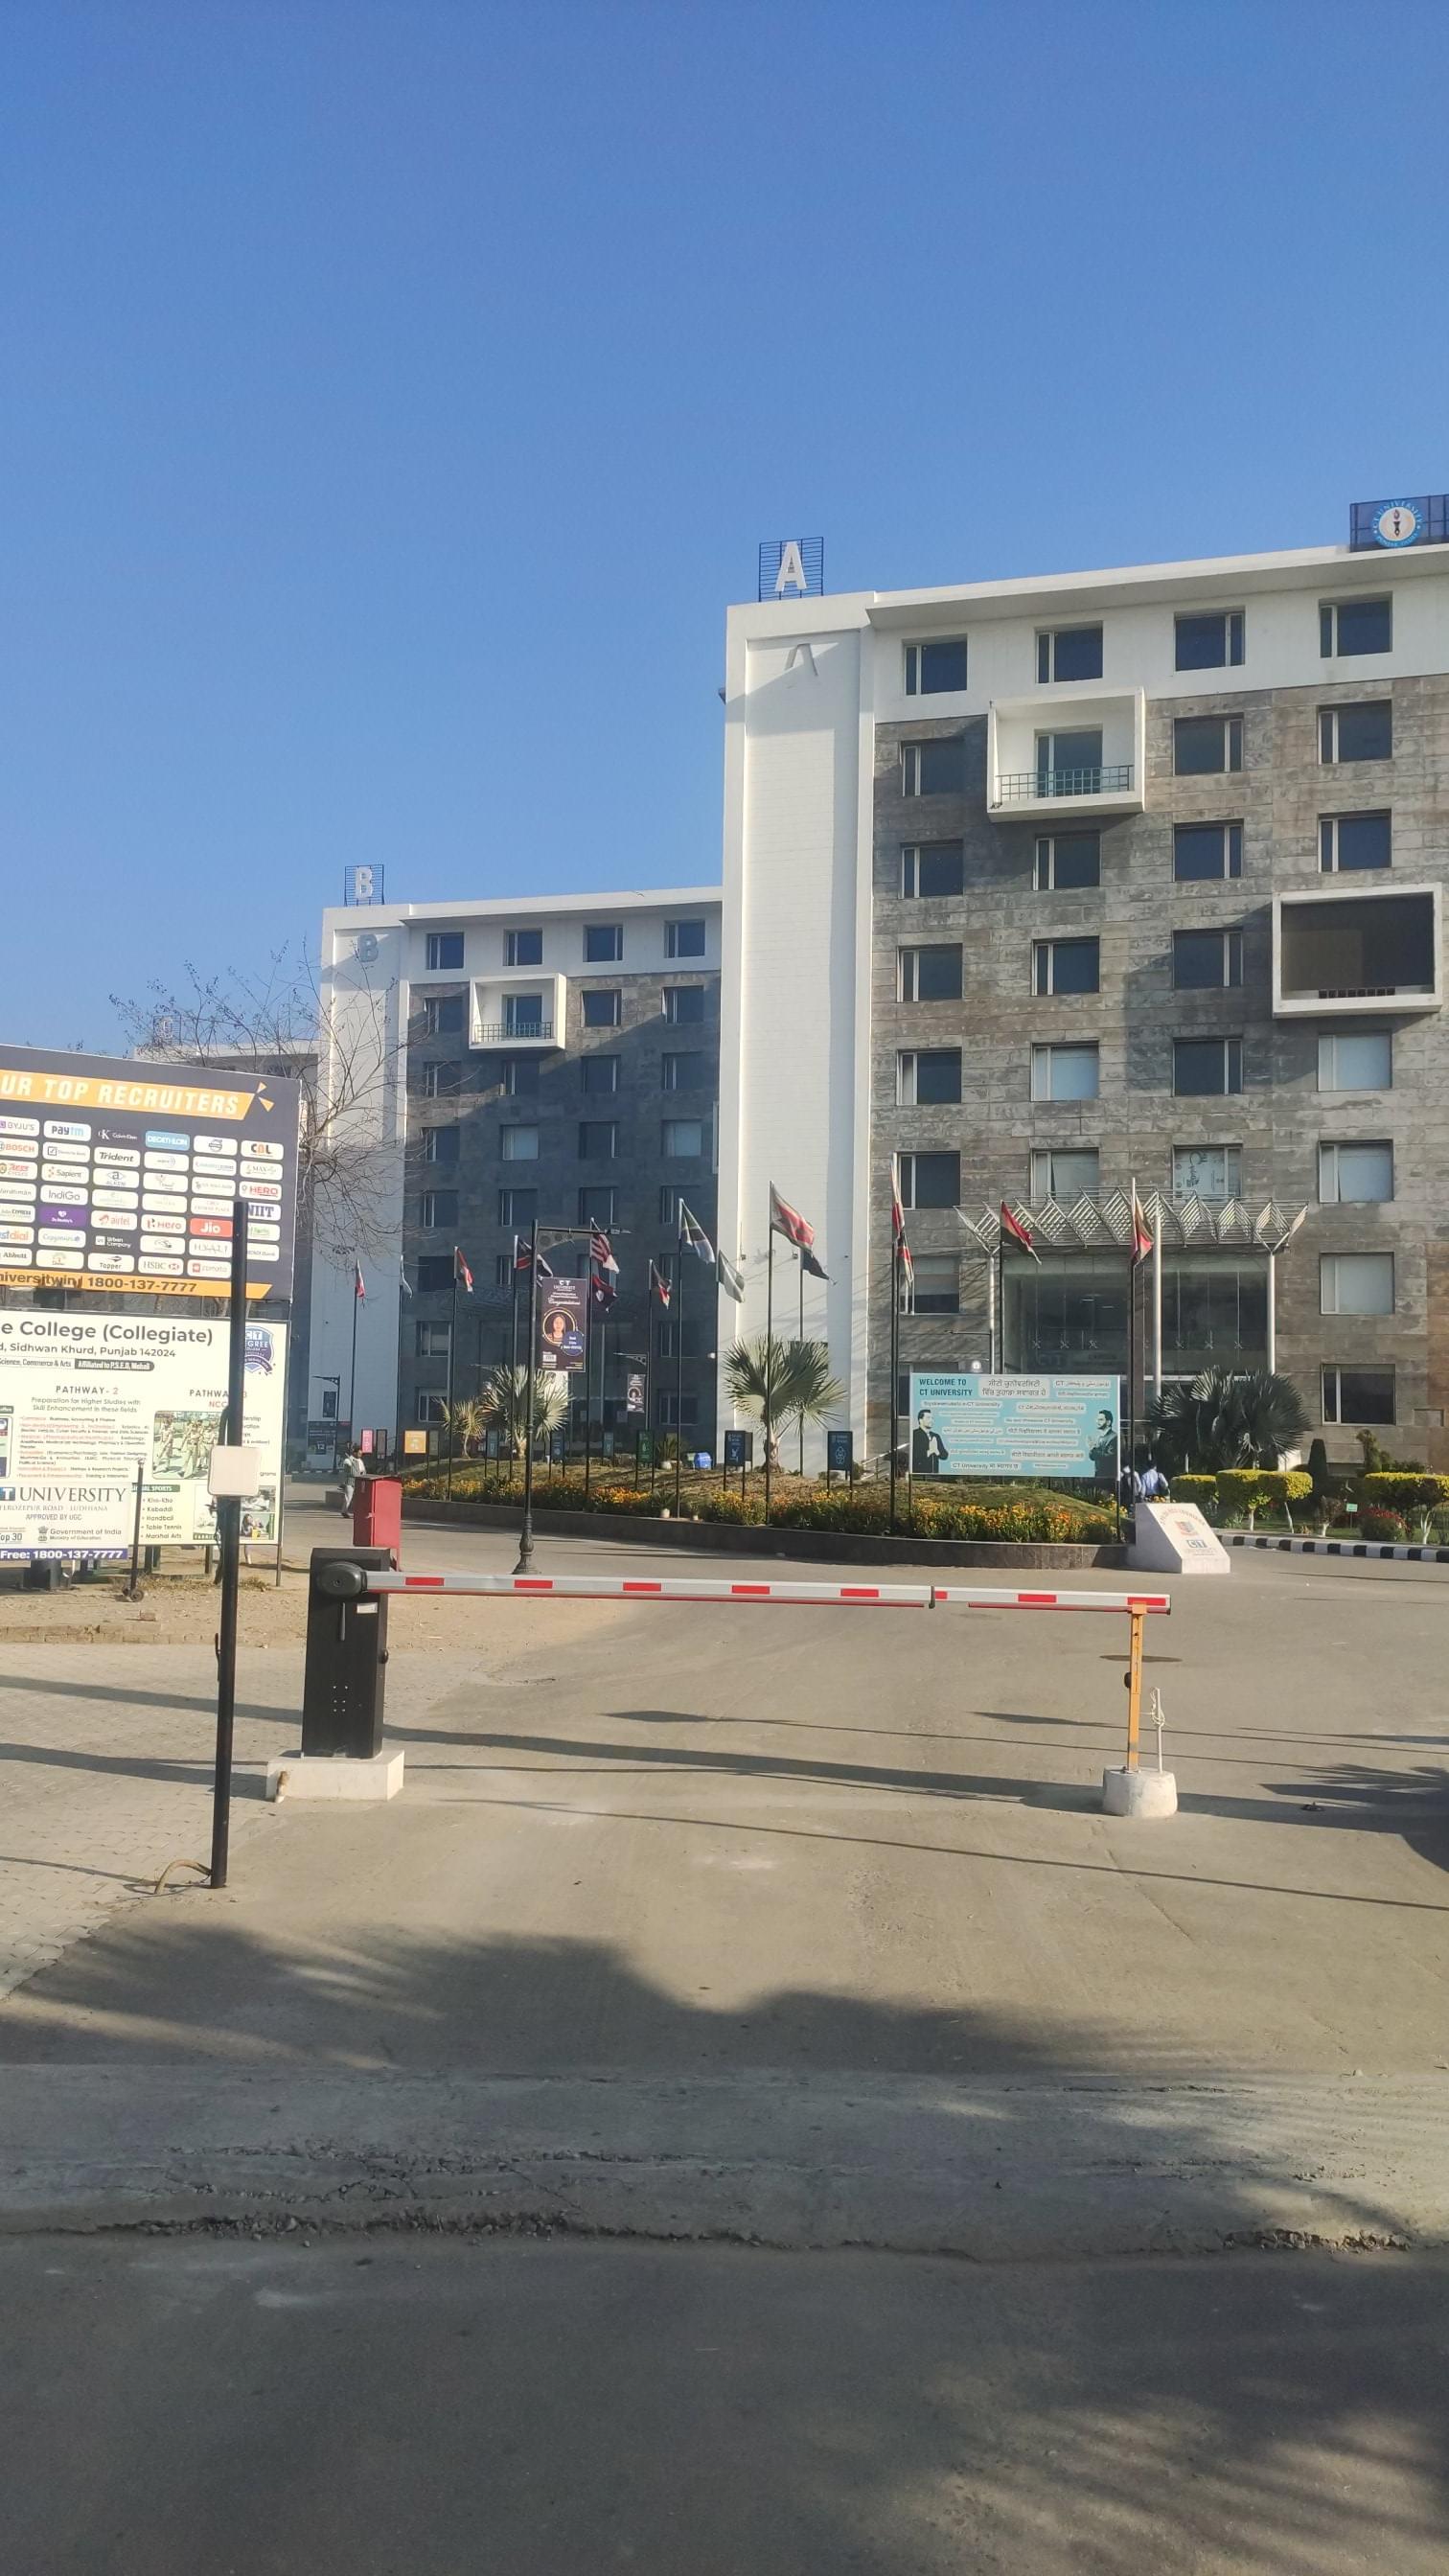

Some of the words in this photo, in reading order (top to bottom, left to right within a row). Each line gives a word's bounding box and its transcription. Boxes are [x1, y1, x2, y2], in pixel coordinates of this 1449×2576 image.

[774, 540, 808, 592] A
[355, 866, 374, 899] B
[1, 1074, 33, 1096] UR
[44, 1079, 89, 1101] TOP
[98, 1084, 239, 1115] RECRUITERS
[51, 1125, 84, 1137] paytm
[6, 1143, 34, 1153] BOSCH
[99, 1151, 134, 1162] Trident
[56, 1168, 82, 1179] Sapient
[48, 1189, 80, 1202] IndiGo
[249, 1184, 279, 1197] HERO
[248, 1205, 275, 1218] NIIT
[156, 1221, 183, 1230] Hero
[199, 1222, 221, 1234] Jio
[143, 1260, 166, 1270] HSBC
[87, 1277, 197, 1292] 1800-137-7777
[19, 1321, 97, 1342] College
[103, 1323, 214, 1346] (Collegiate)
[10, 1342, 58, 1354] Sidhwan
[60, 1345, 97, 1357] Khurd,
[100, 1346, 137, 1357] Punjab
[140, 1347, 177, 1358] 142024
[23, 1358, 53, 1367] Commerce
[919, 1378, 954, 1387] WELCOME
[957, 1378, 967, 1387] TO
[113, 1387, 120, 1395] 2
[189, 1389, 229, 1398] PATHWA
[31, 1396, 70, 1405] Preparation
[19, 1486, 126, 1503] UNIVERSITY
[12, 1532, 23, 1541] 30
[50, 1528, 94, 1536] Government
[1, 1550, 30, 1559] Free:
[33, 1550, 124, 1559] 1800-137-7777
